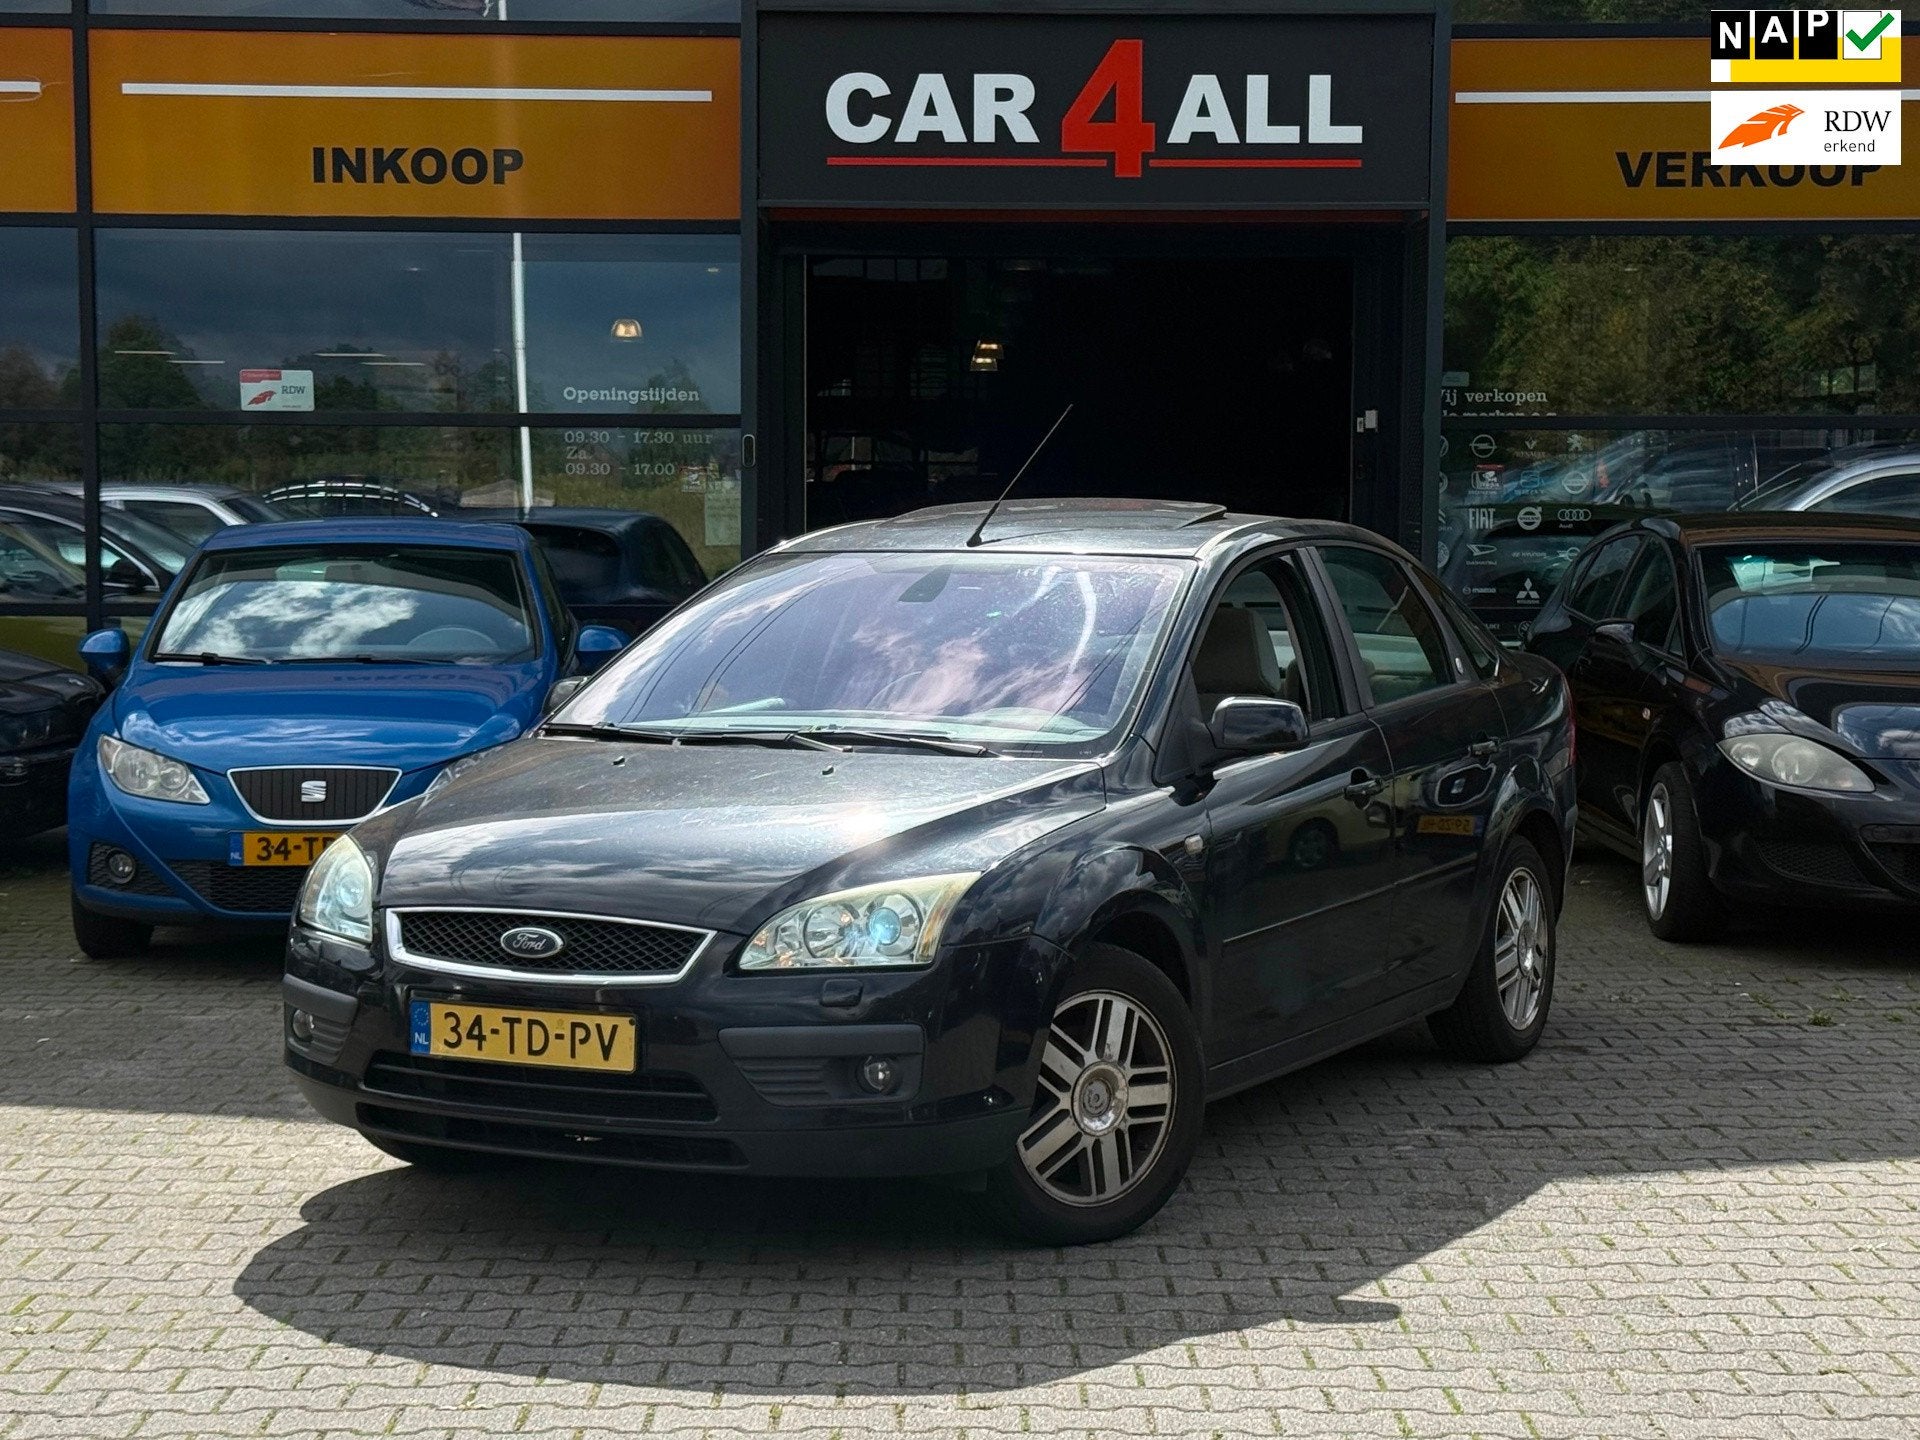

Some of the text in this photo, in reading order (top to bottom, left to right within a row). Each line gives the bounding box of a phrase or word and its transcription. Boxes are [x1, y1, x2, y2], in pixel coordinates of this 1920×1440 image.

[825, 39, 1363, 178] CAR 4 ALL
[312, 147, 524, 185] INKOOP
[281, 385, 306, 395] RDW
[563, 386, 700, 404] Openingstijden
[1464, 388, 1549, 406] verkopen
[564, 431, 610, 443] 09.30
[633, 431, 675, 444] 17.30
[682, 434, 714, 444] uur
[565, 462, 611, 475] 09.30
[634, 463, 675, 475] 17.00
[1468, 508, 1496, 530] FIAT
[512, 933, 546, 951] Ford
[414, 1032, 429, 1046] NL
[443, 1011, 619, 1062] 34-TD-PV
